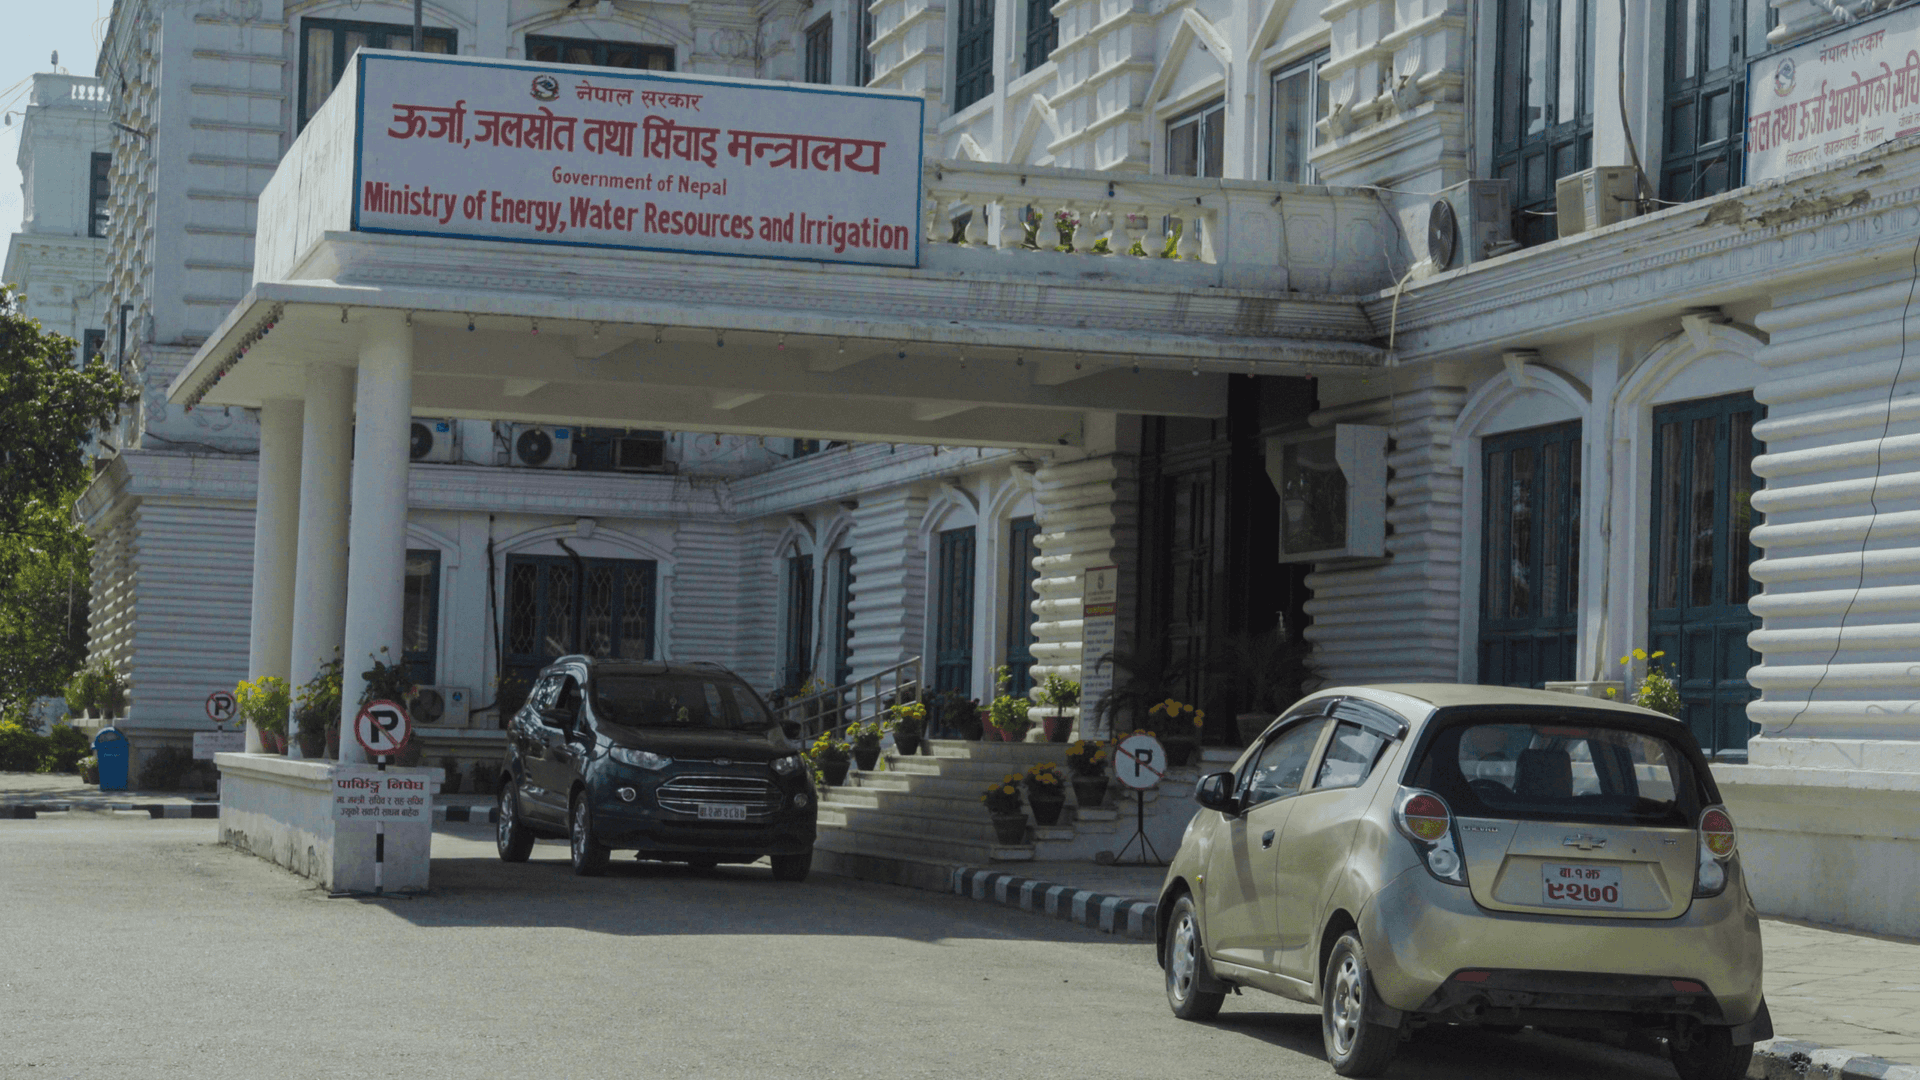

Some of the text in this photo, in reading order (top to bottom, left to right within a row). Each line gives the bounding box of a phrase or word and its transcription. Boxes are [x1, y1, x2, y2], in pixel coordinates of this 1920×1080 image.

[1819, 29, 1886, 65] नेपाल सरकार
[574, 80, 704, 112] नेपाल सरकार
[1747, 50, 1920, 154] जल तथा ऊर्जा आयोगको सचि
[582, 118, 638, 158] तथा
[642, 114, 721, 169] सिंचाइ
[727, 129, 887, 175] मन्त्रालय
[552, 165, 728, 200] Government of Nepal
[363, 180, 909, 254] Ministry of Energy, Water Resources and Irrigation
[387, 777, 425, 791] निषेध
[1547, 883, 1619, 903] ९२७०
